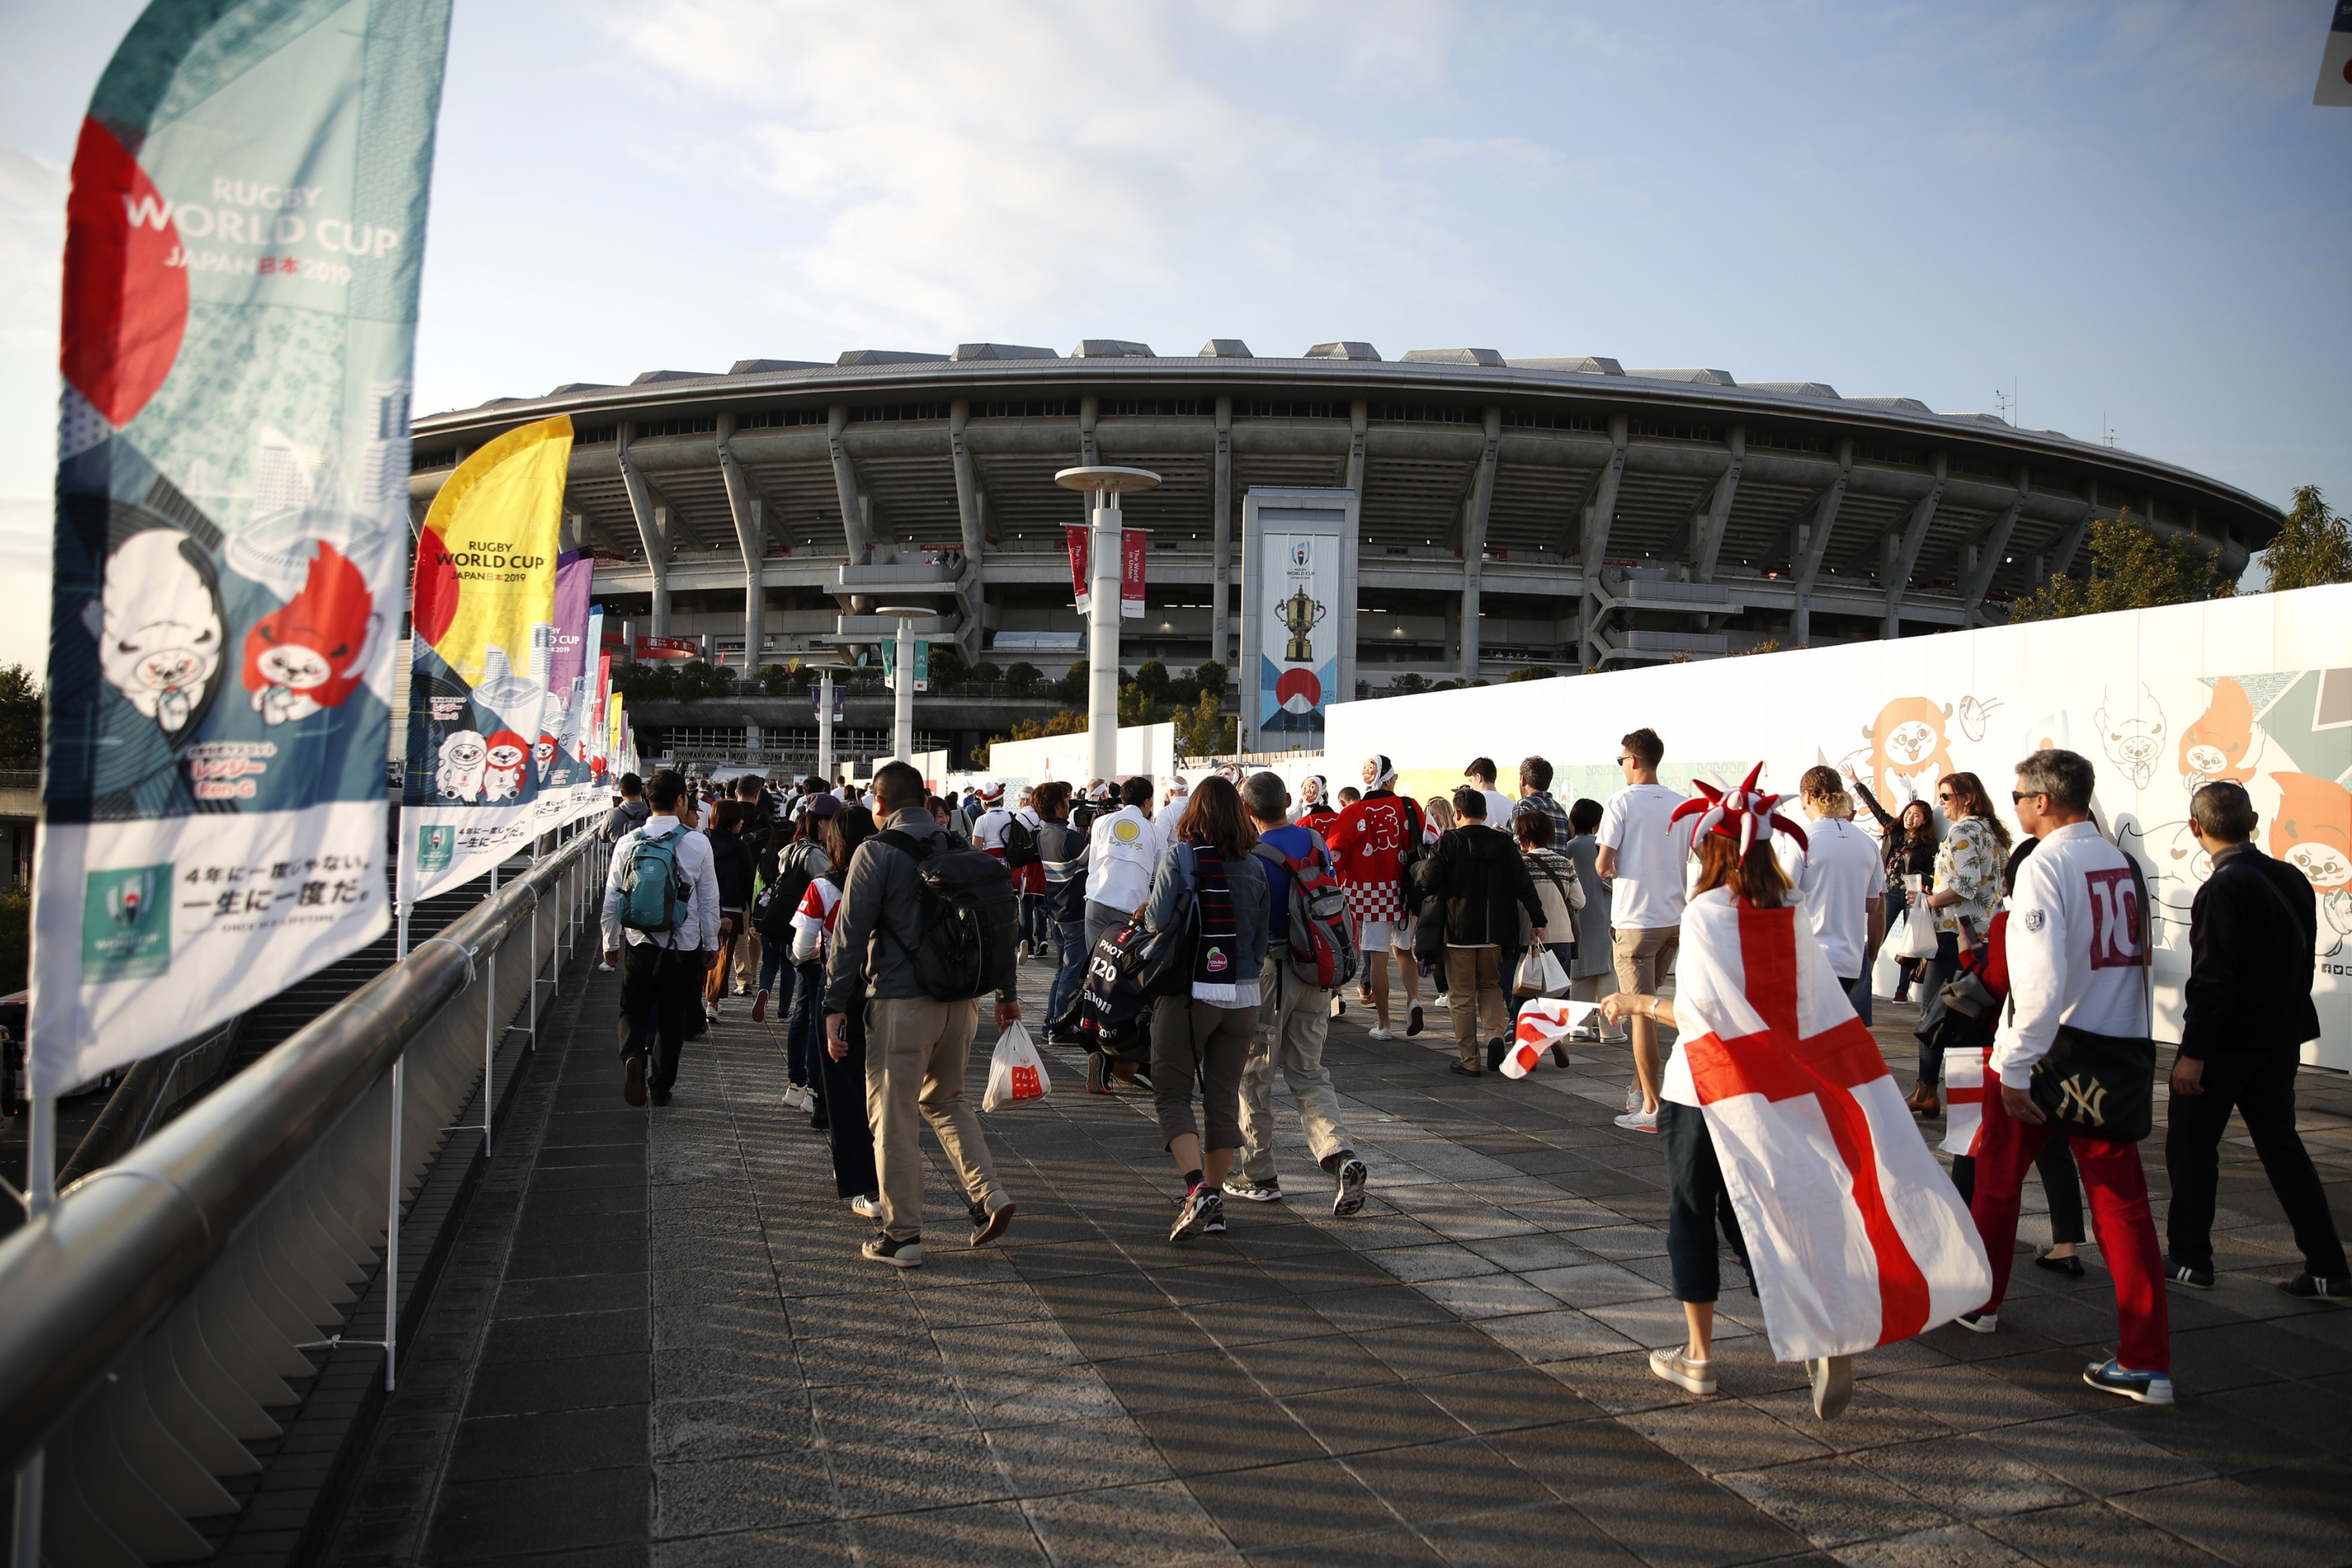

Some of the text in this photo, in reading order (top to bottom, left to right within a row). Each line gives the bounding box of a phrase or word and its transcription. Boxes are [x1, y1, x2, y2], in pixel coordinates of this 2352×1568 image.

[212, 177, 322, 209] RUGBY
[122, 194, 401, 257] WORLD CUP
[435, 553, 544, 569] WORLD CUP
[469, 541, 513, 553] RUGBY
[559, 636, 580, 644] CUP
[1365, 804, 1399, 852] 祭
[1109, 837, 1143, 850] シューイチ
[2092, 878, 2149, 958] 10
[1091, 956, 1117, 982] 120
[2056, 1073, 2107, 1127] NY
